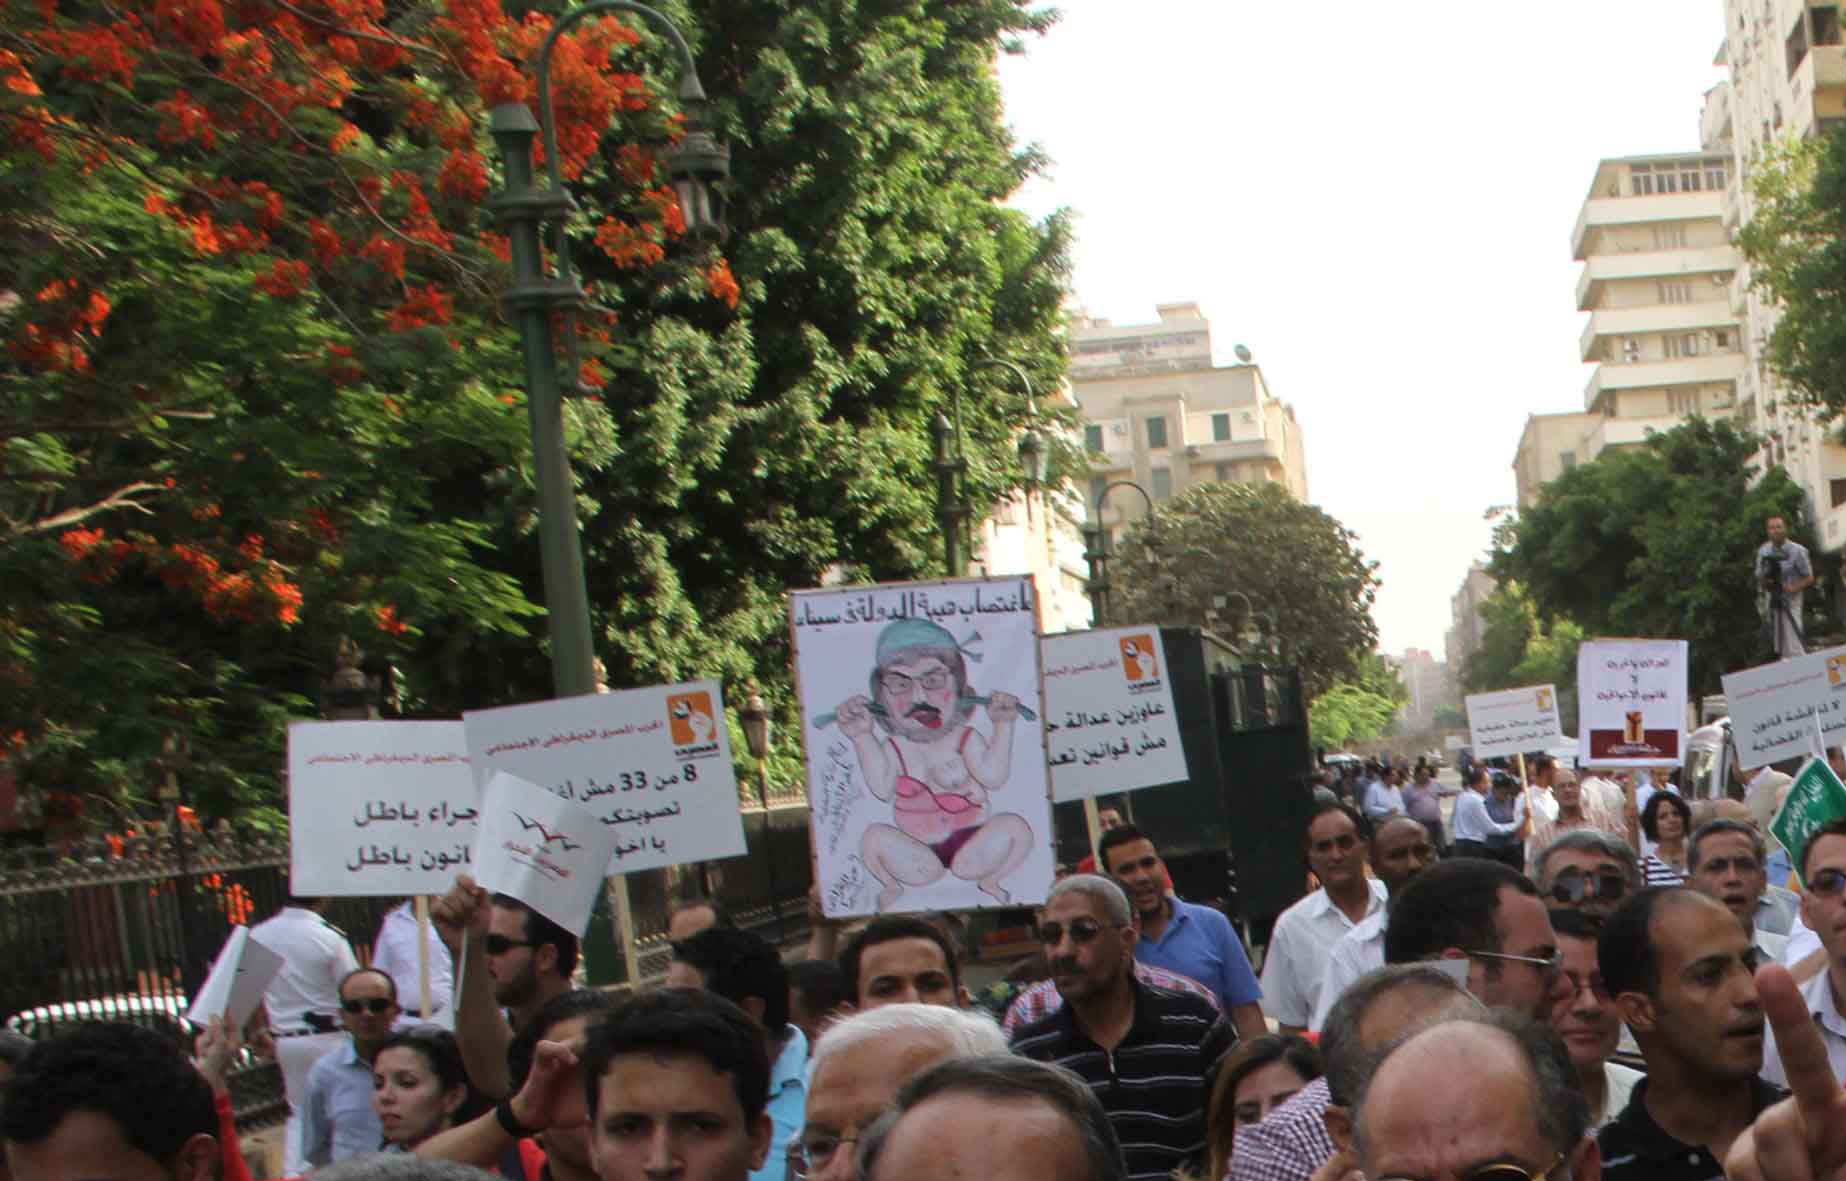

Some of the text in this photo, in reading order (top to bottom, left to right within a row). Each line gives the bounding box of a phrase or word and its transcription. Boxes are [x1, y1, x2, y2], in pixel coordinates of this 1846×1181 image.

[1066, 712, 1111, 729] عدالة
[1115, 701, 1165, 726] عاوزين
[1083, 737, 1130, 765] قوانين
[1135, 730, 1167, 756] مش
[619, 770, 648, 792] 33
[653, 775, 680, 791] من
[683, 763, 698, 782] 8
[580, 779, 616, 803] مش
[353, 800, 480, 828] جراء باطل
[346, 845, 412, 873] باطل
[420, 845, 472, 872] انون
